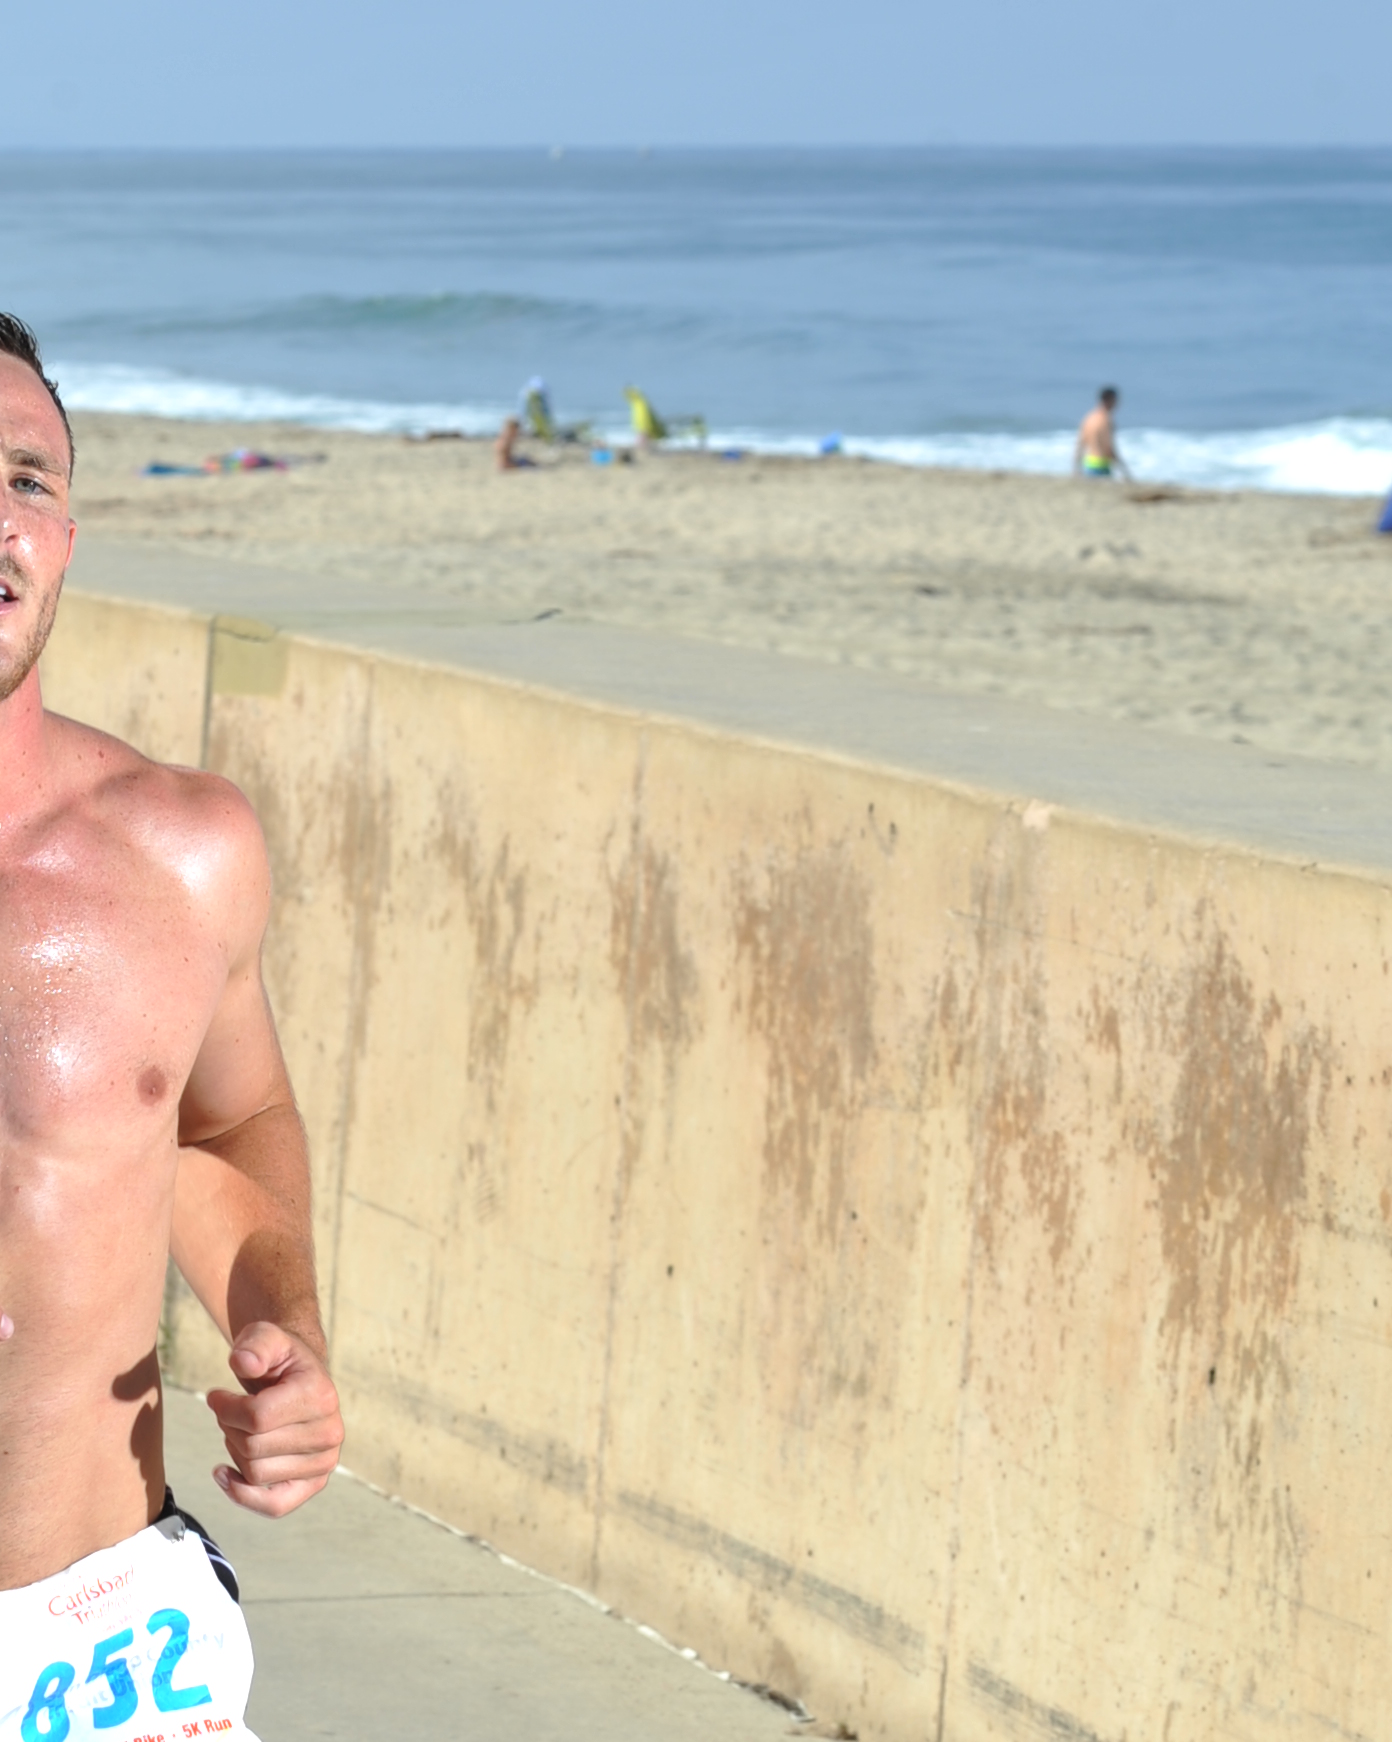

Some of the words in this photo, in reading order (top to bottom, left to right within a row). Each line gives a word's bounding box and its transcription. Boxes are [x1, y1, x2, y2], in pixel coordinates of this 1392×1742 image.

[48, 1564, 134, 1617] Carlsbad
[181, 1721, 203, 1739] 5K
[203, 1717, 233, 1734] Run
